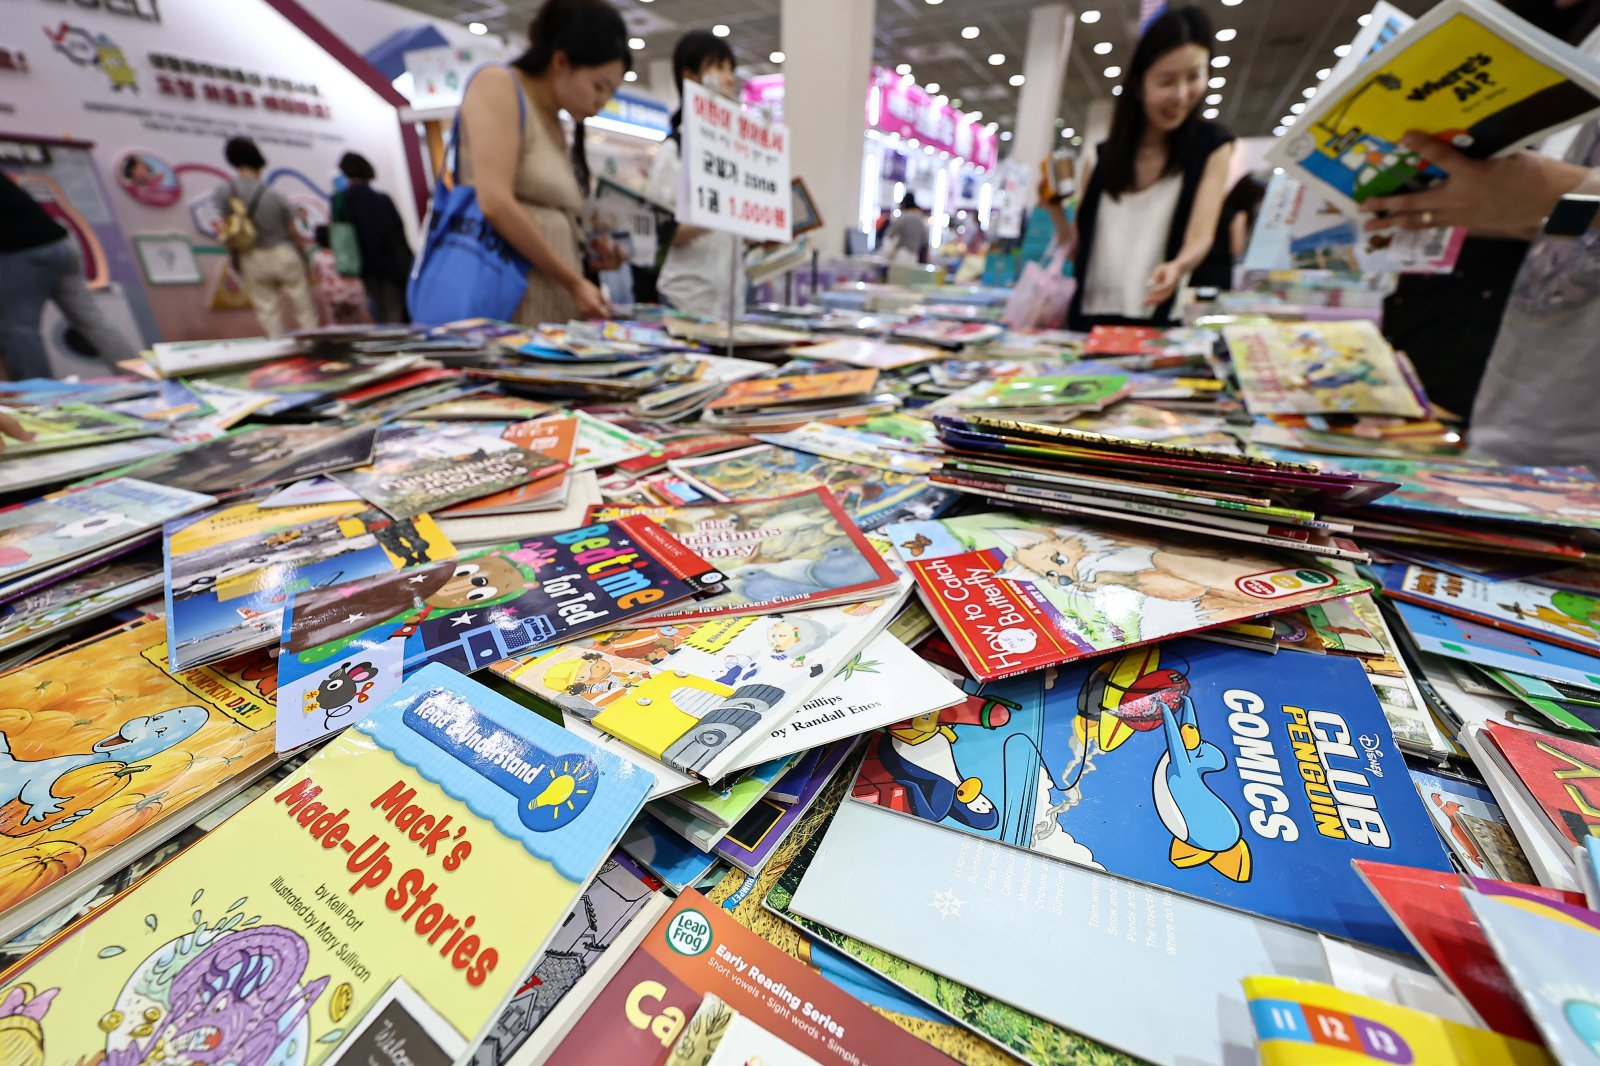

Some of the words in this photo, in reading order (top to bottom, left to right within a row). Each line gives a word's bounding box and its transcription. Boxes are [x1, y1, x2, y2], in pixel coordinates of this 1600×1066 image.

[1406, 52, 1493, 101] Where's
[697, 542, 761, 558] tory
[553, 524, 665, 610] Bedtime
[925, 559, 970, 602] Catch
[543, 573, 582, 599] for
[963, 567, 1026, 627] Butterfly
[556, 591, 610, 627] Ted
[698, 605, 724, 615] Tara
[727, 600, 769, 611] Larsen
[772, 592, 811, 604] Chang
[964, 604, 986, 621] to
[977, 624, 1022, 670] How
[1010, 669, 1029, 678] READY
[225, 696, 263, 719] DAY!
[790, 709, 846, 732] Randall
[847, 701, 882, 715] Enos
[796, 696, 843, 713] hillips
[413, 700, 450, 727] Read
[460, 722, 545, 785] Understand
[672, 762, 685, 773] Dial
[1223, 689, 1300, 842] COMICS
[1281, 705, 1348, 840] PENGUIN
[1308, 710, 1392, 849] CLUB
[371, 780, 472, 872] Mack's
[274, 777, 393, 895] Made-Up
[385, 868, 499, 987] Stories
[732, 877, 755, 904] RUMPET
[1107, 889, 1119, 906] and
[315, 883, 330, 901] by
[325, 894, 349, 916] Kelli
[342, 909, 365, 932] Port
[1088, 904, 1100, 928] Then
[1126, 892, 1137, 909] and
[1164, 909, 1175, 922] do
[270, 875, 312, 917] illustrated
[304, 910, 320, 929] by
[314, 921, 341, 952] Mary
[336, 943, 371, 984] Sullivan
[677, 914, 708, 940] Leap
[1107, 909, 1119, 936] Snow
[1126, 910, 1138, 943] Ponds
[1145, 929, 1157, 948] The
[672, 928, 704, 951] Frog
[1165, 924, 1178, 956] Where
[714, 943, 749, 973] Early
[748, 965, 802, 1011] Reading
[802, 1001, 845, 1039] Series
[708, 957, 730, 978] Short
[732, 974, 760, 998] vowels
[766, 997, 790, 1020] Sight
[791, 1014, 820, 1040] words
[827, 1039, 861, 1066] Simple
[1271, 1007, 1297, 1031] 11
[1317, 1014, 1350, 1042] 12
[1365, 1026, 1398, 1055] 13
